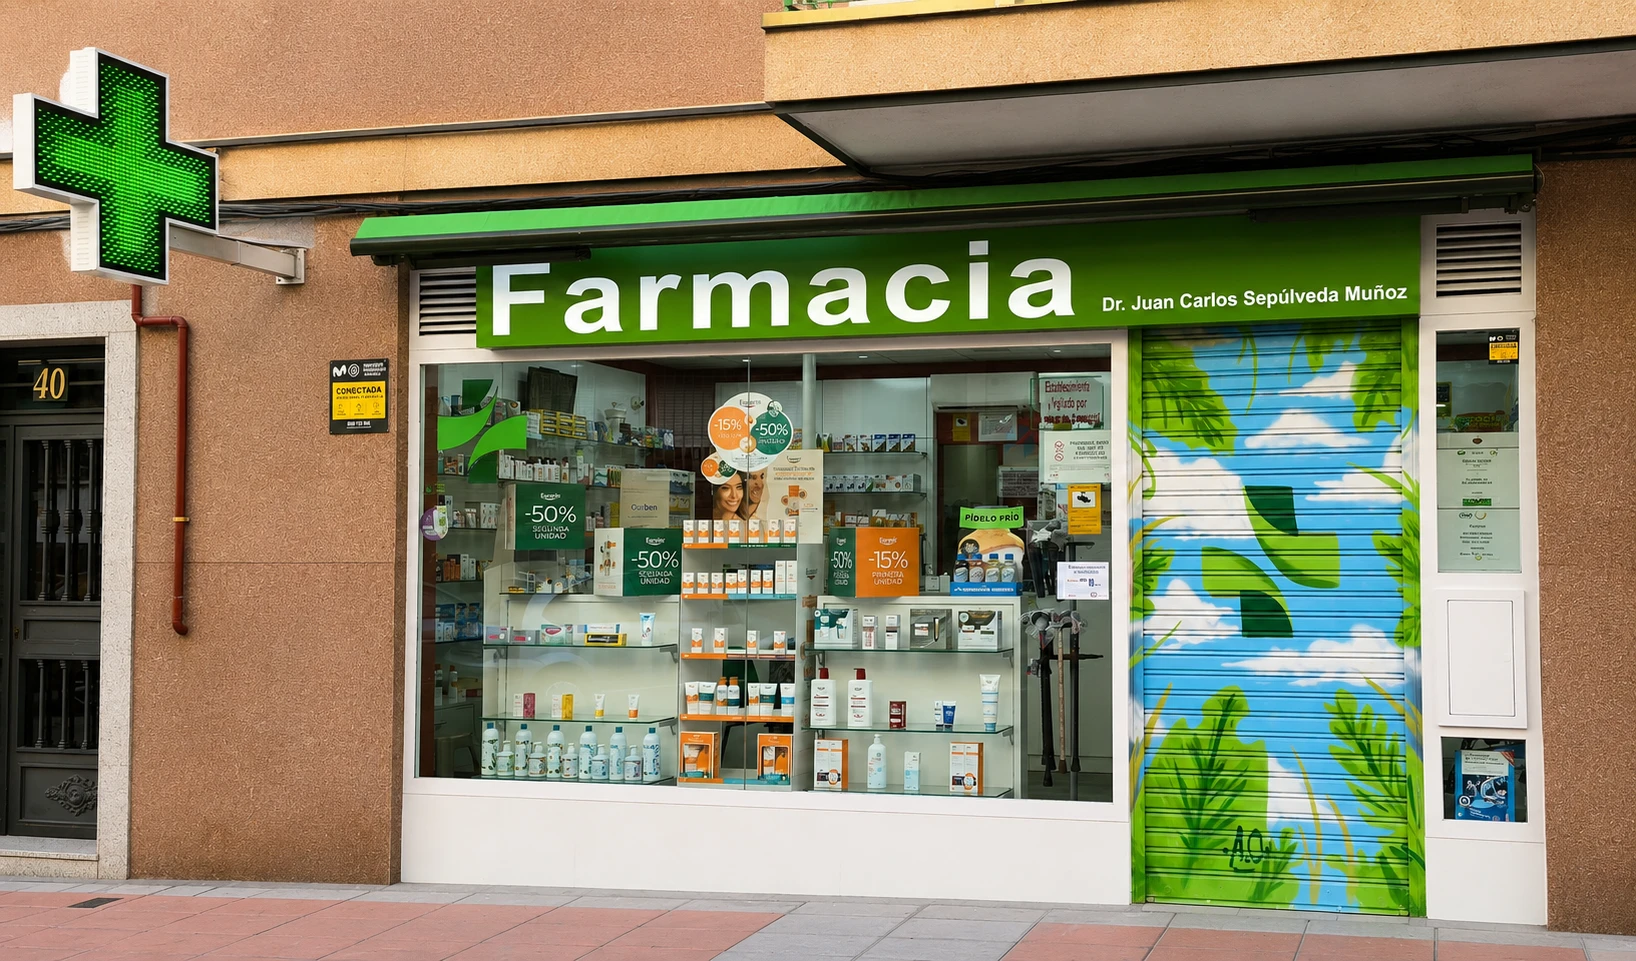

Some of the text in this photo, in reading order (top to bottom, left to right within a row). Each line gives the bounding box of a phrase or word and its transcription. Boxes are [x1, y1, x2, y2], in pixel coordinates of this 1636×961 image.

[492, 240, 1075, 335] Farmacia
[1102, 284, 1408, 312] Dr. Juan Carlos Sepúlveda Muñoz
[33, 367, 65, 399] 40
[336, 386, 382, 395] CONECTADA
[755, 422, 789, 436] -50%
[525, 505, 577, 523] -50%
[631, 550, 680, 569] -50%
[830, 551, 853, 569] -50%
[868, 550, 909, 569] -15%
